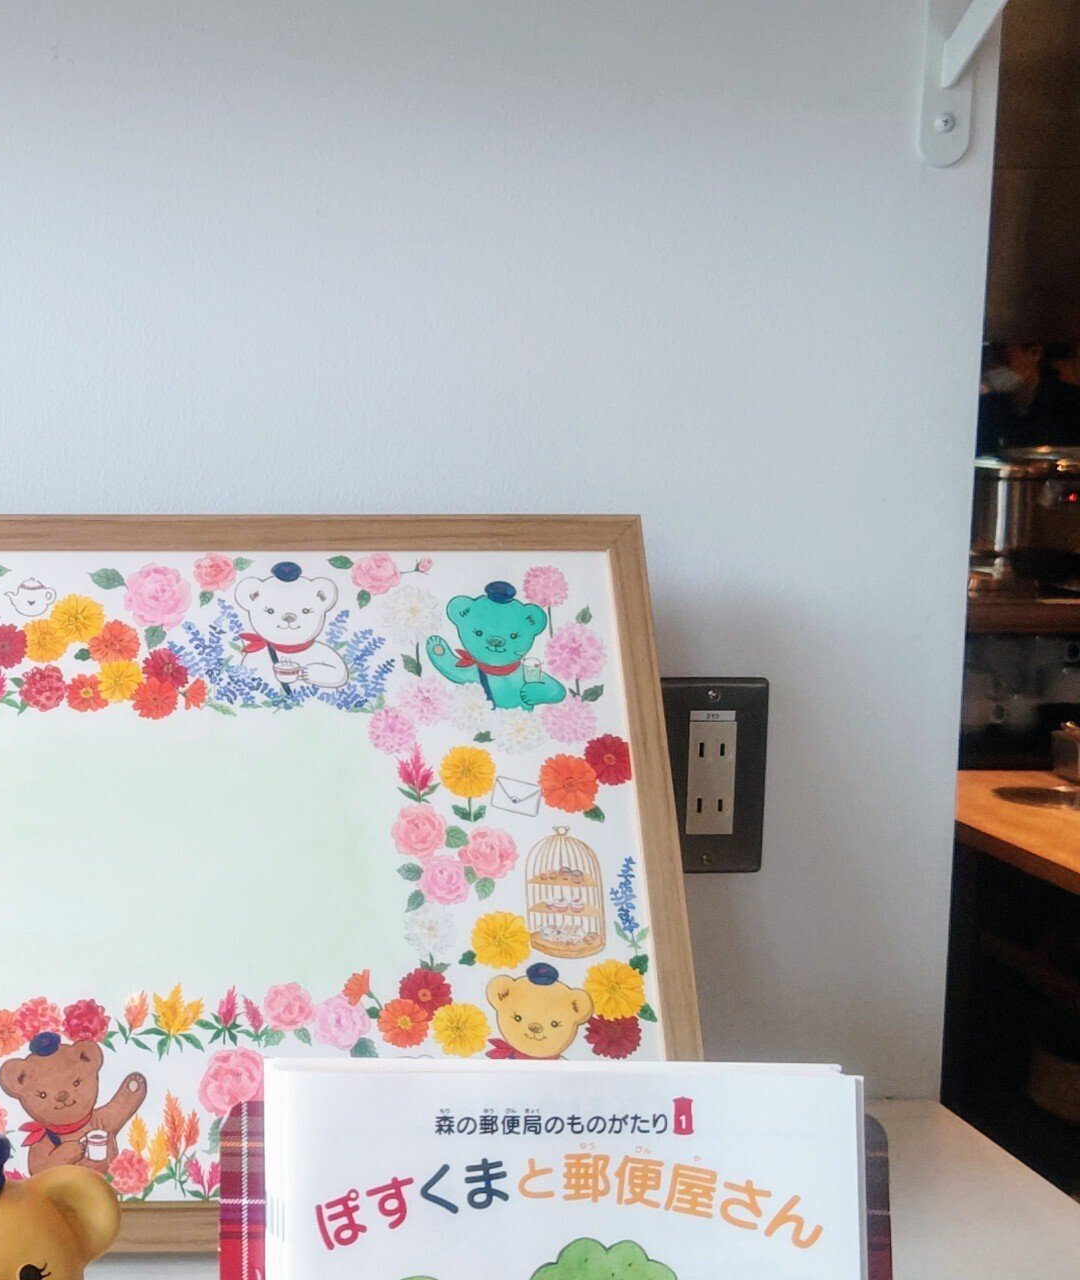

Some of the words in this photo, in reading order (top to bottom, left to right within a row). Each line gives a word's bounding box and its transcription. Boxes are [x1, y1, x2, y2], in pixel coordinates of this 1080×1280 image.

[435, 1113, 668, 1135] 森の郵便局のものがたり
[678, 1114, 687, 1130] 1
[315, 1152, 823, 1250] ぽすくまと郵便屋さん
